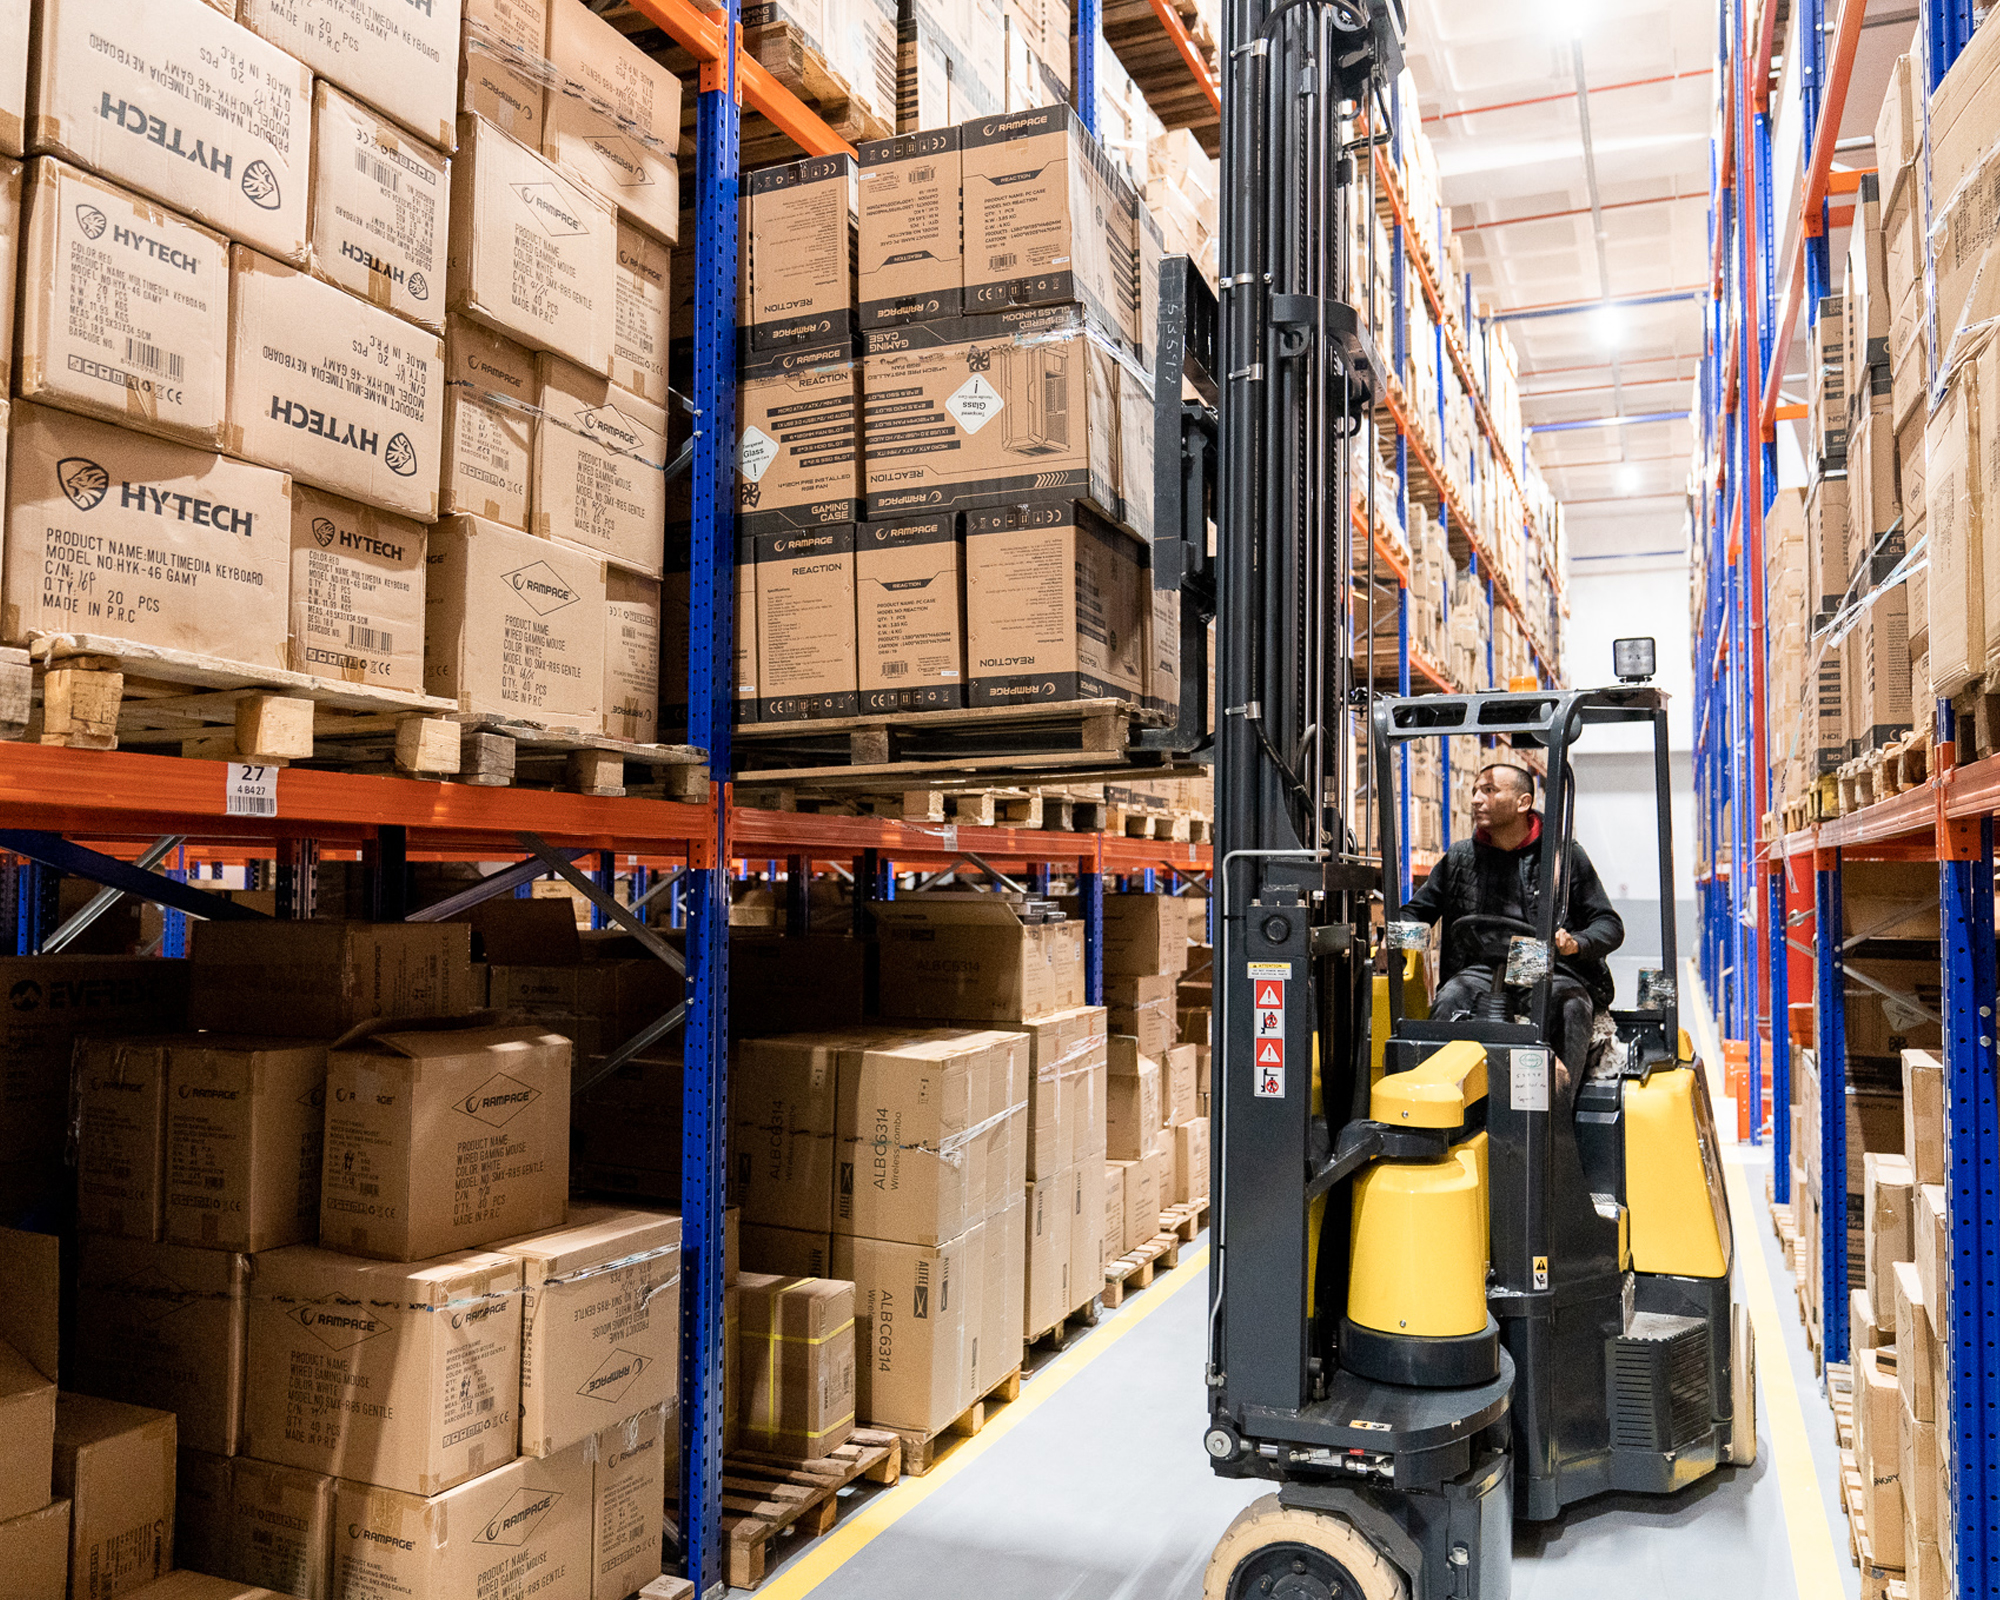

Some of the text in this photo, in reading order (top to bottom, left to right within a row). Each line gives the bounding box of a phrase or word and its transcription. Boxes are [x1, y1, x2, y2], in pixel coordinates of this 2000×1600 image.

[271, 3, 302, 27] MADE
[304, 21, 314, 36] IN
[363, 18, 387, 40] GAMY
[318, 16, 359, 51] 20 PCS
[89, 33, 144, 72] KEYBOARD
[199, 47, 244, 83] 20 PCS
[248, 63, 259, 79] IN
[266, 72, 291, 98] MADE
[164, 60, 289, 138] MODEL GAMY
[998, 115, 1047, 131] RAMPAGE
[101, 93, 231, 177] HYTECH
[248, 121, 288, 152] PRODUCT
[593, 141, 634, 174] RAMPAGE
[1000, 173, 1031, 182] REACTION
[983, 194, 1007, 203] PRODUCT
[536, 197, 578, 229] RAMPAGE
[113, 225, 196, 273] HYTECH
[342, 241, 404, 283] HYTECH
[763, 298, 812, 312] REACTION
[877, 304, 923, 317] RAMPAGE
[1002, 310, 1036, 321] WINDOW
[772, 324, 816, 338] RAMPAGE
[868, 331, 899, 343] CASE
[352, 339, 388, 366] 20 PCS
[392, 346, 401, 359] IN
[869, 339, 908, 352] GAMING
[262, 345, 306, 372] KEYBOARD
[406, 352, 427, 372] MADE
[797, 350, 840, 365] RAMPAGE
[322, 356, 424, 409] MODEL GAMY
[480, 363, 521, 387] RAMPAGE
[798, 372, 848, 386] REACTION
[390, 398, 424, 422] PRODUCT
[962, 401, 986, 410] Glass
[271, 396, 377, 453] HYTECH
[597, 420, 634, 444] RAMPAGE
[743, 447, 764, 458] Glass
[869, 469, 923, 482] REACTION
[121, 481, 253, 537] HYTECH
[811, 501, 848, 514] GAMING
[878, 494, 926, 506] RAMPAGE
[819, 510, 848, 521] CASE
[890, 524, 938, 538] RAMPAGE
[339, 532, 402, 560] HYTECH
[788, 536, 833, 550] RAMPAGE
[46, 527, 102, 550] PRODUCT
[215, 564, 263, 585] KEYBOARD
[46, 544, 196, 586] MODEL GAMY
[308, 559, 332, 572] PRODUCT
[308, 569, 328, 581] MODEL
[791, 562, 842, 575] REACTION
[327, 581, 351, 595] 20 PCS
[526, 580, 568, 600] RAMPAGE
[42, 593, 135, 623] MADE IN P.R.C
[107, 589, 159, 612] 20 PCS
[504, 614, 531, 630] PRODUCT
[979, 656, 1034, 667] REACTION
[534, 683, 547, 695] PCS
[990, 684, 1039, 696] RAMPAGE
[242, 765, 265, 781] 27
[482, 1090, 529, 1107] RAMPAGE
[873, 1108, 889, 1190] ALBC6314
[890, 1111, 902, 1190] Wireless combo
[318, 1314, 374, 1331] RAMPAGE
[879, 1290, 893, 1372] ALBC6314
[589, 1366, 630, 1391] RAMPAGE
[502, 1497, 550, 1530] RAMPAGE
[363, 1529, 412, 1550] RAMPAGE
[477, 1548, 529, 1585] PRODUCT NAME
